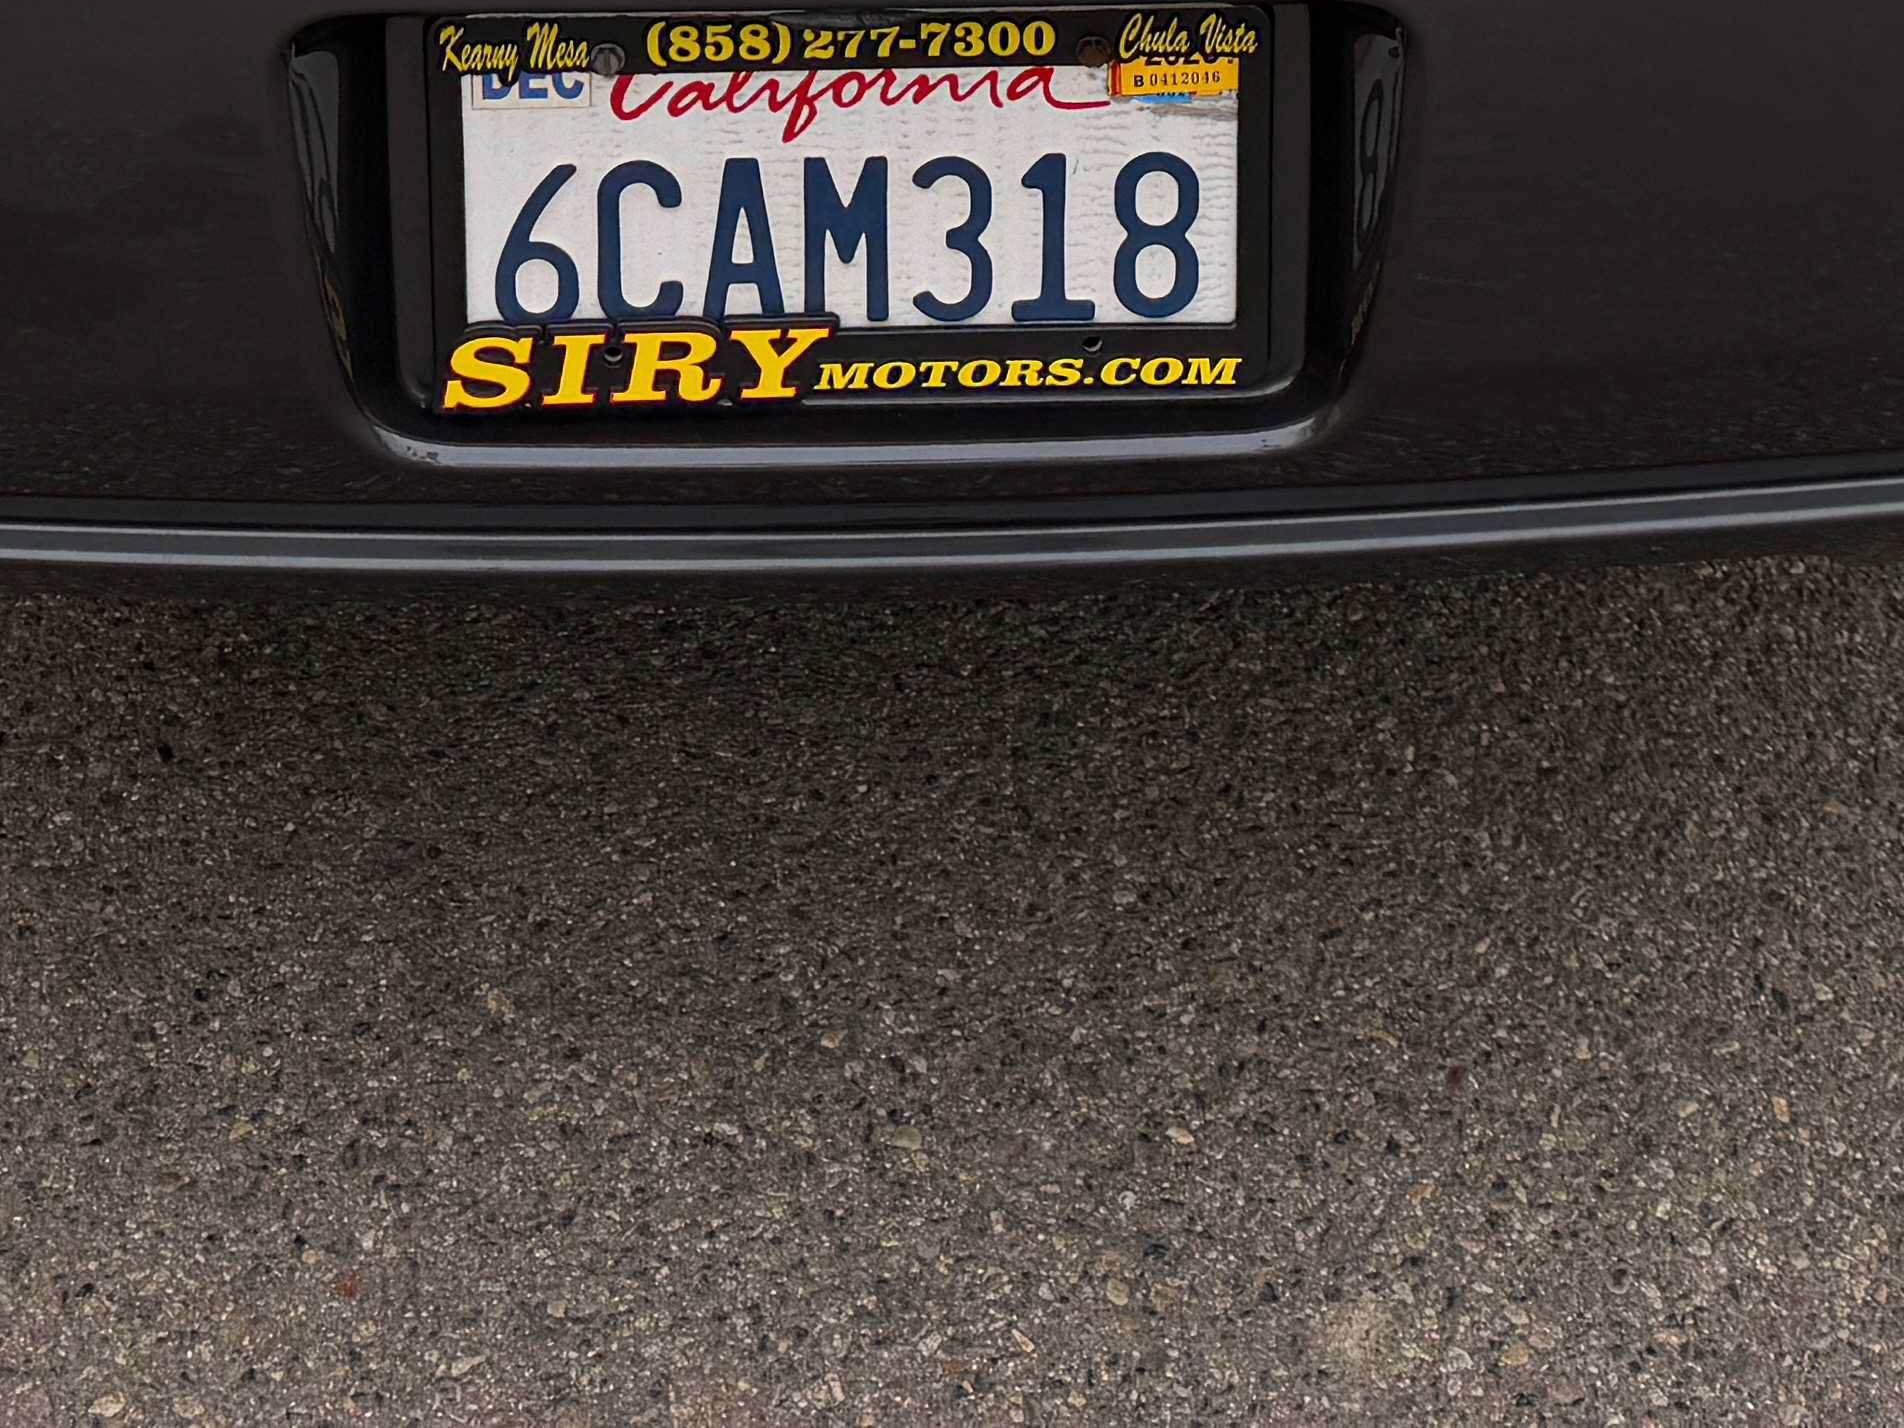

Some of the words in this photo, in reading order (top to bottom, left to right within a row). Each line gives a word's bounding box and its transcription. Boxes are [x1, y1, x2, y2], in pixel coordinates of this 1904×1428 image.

[439, 24, 519, 83] Kearny
[526, 21, 591, 69] Mesa
[646, 20, 791, 67] (858)
[802, 20, 1056, 60] 277-7300
[1119, 11, 1191, 60] Chula
[1200, 12, 1259, 55] Vista
[609, 66, 1112, 143] California
[1133, 74, 1145, 89] B
[495, 152, 1201, 323] 6CAM318
[442, 327, 832, 409] SIRY
[813, 357, 1244, 391] MOTORS.COM
